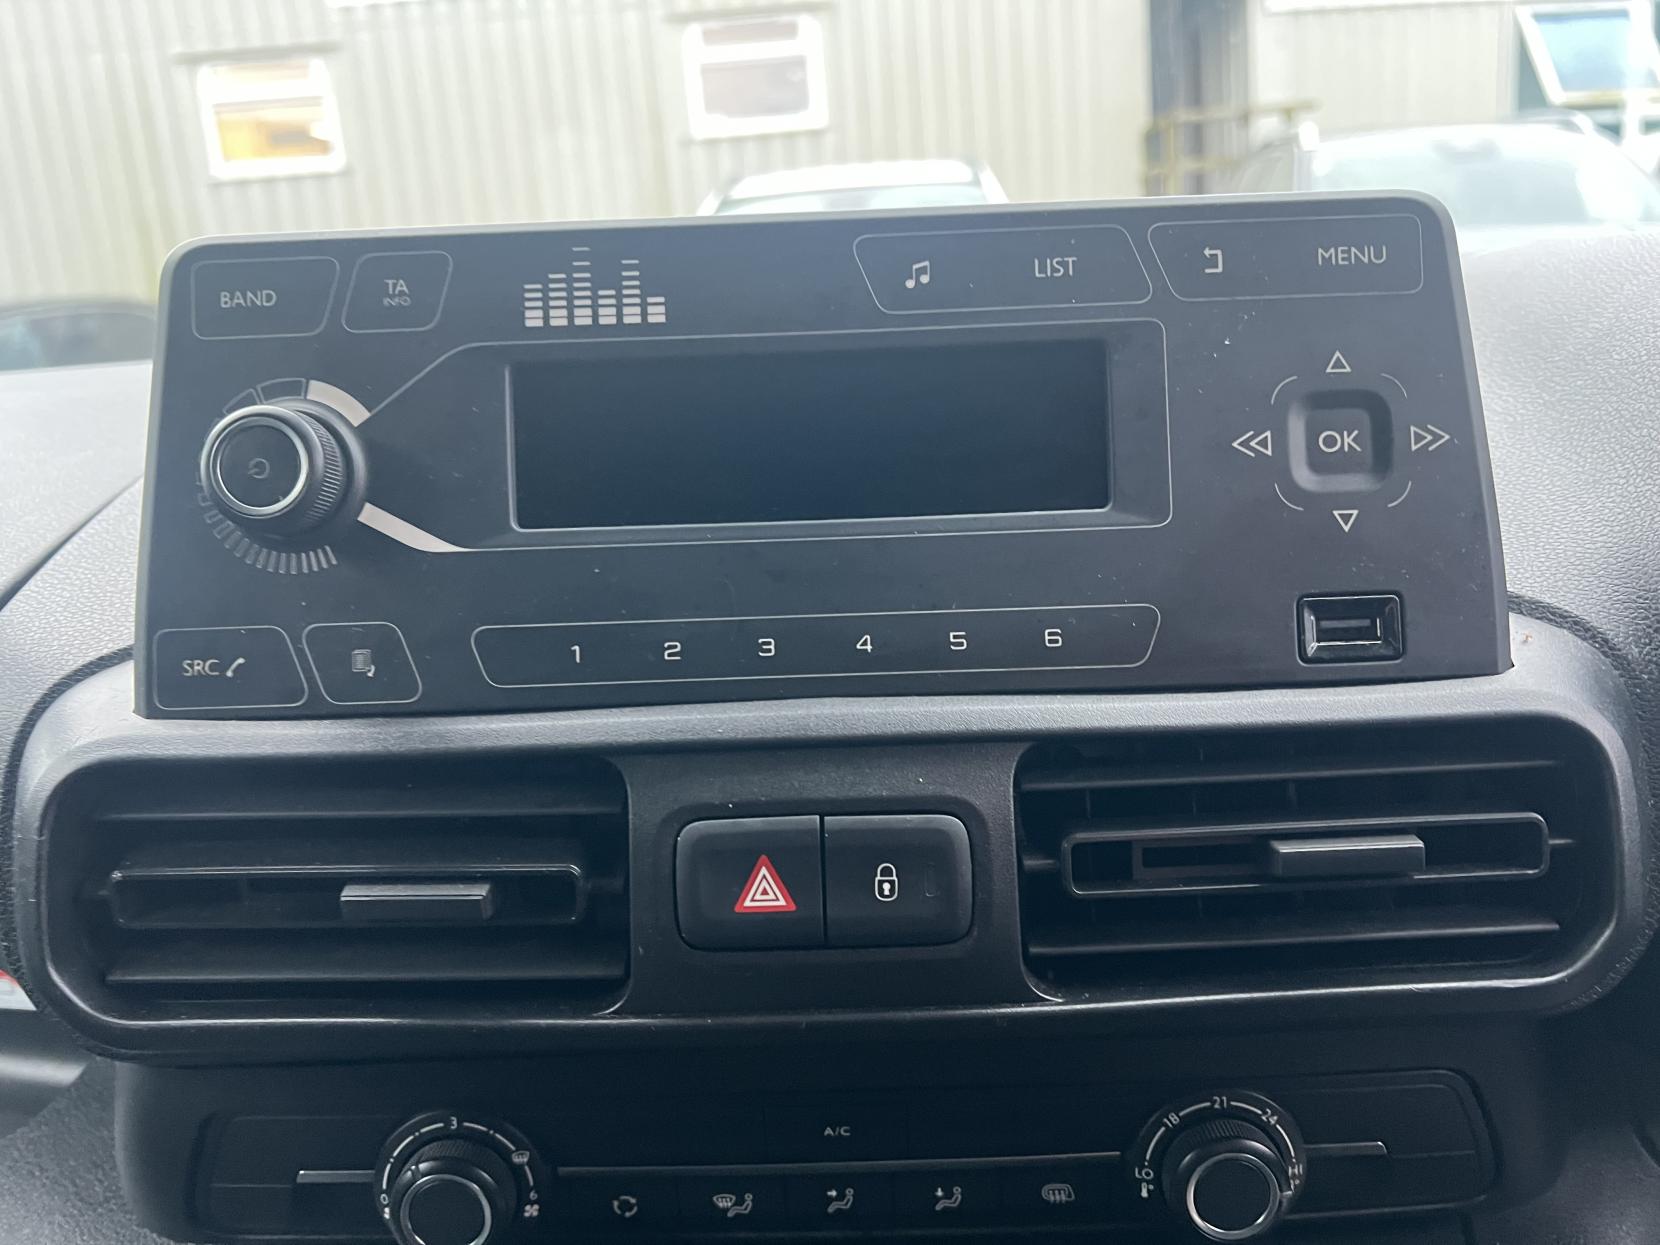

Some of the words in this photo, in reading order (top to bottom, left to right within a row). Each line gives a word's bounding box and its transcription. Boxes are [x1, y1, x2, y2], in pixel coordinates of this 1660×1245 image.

[1317, 246, 1387, 267] MENU
[1034, 257, 1077, 278] LIST
[384, 279, 409, 294] TA
[220, 290, 277, 308] BAND
[1318, 430, 1362, 453] OK
[571, 645, 581, 664] 1
[663, 641, 682, 660] 2
[758, 638, 776, 657] 3
[856, 635, 873, 653] 4
[949, 631, 967, 650] 5
[1044, 628, 1062, 648] 6
[181, 659, 220, 677] SRC
[1163, 1112, 1180, 1129] 18
[1213, 1096, 1228, 1109] 21
[1260, 1108, 1278, 1125] 24
[450, 1116, 458, 1129] 3
[824, 1126, 851, 1137] A/C
